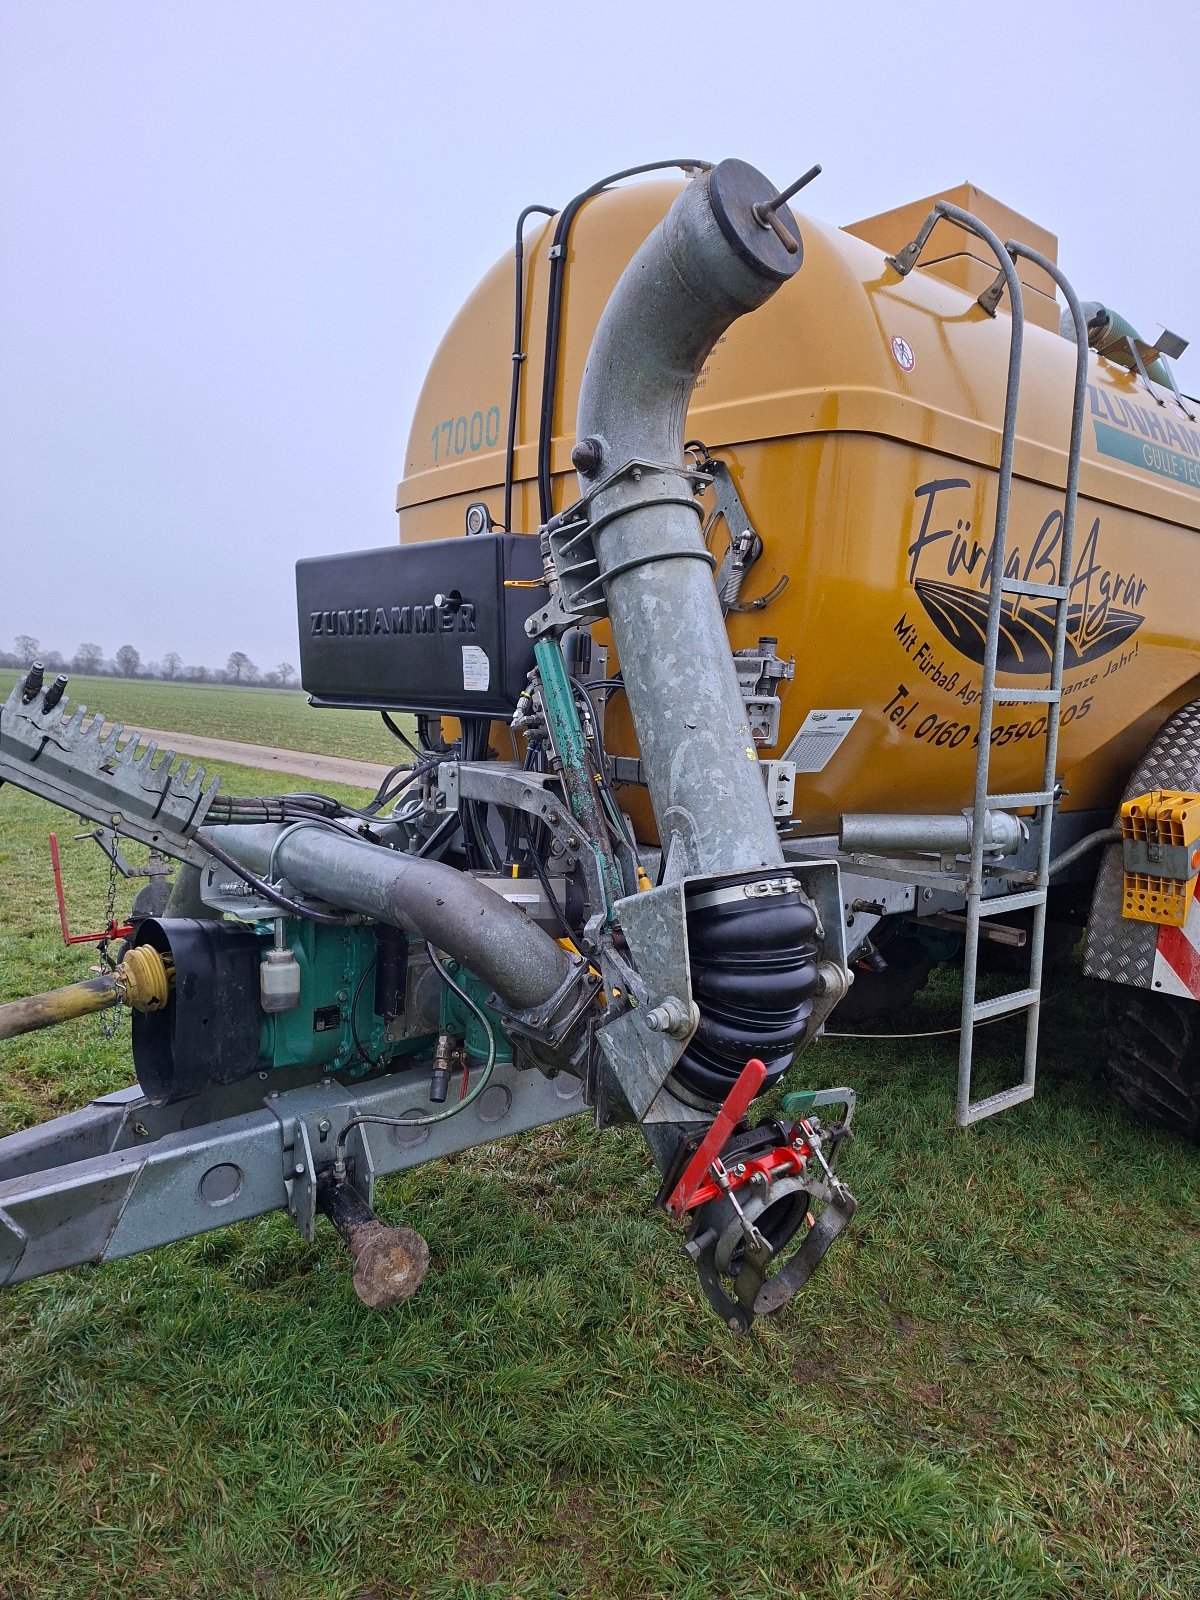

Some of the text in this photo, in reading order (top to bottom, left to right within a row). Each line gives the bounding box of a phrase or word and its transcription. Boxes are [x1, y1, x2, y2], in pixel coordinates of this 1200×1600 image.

[431, 405, 500, 464] 17000
[1068, 516, 1149, 646] Agrar
[310, 603, 477, 638] ZUNHAMMER
[893, 611, 917, 653] Mit
[912, 641, 960, 693] Fürbaß
[1060, 674, 1099, 698] anze
[1102, 641, 1140, 679] Jahr!
[882, 683, 920, 731] Tel.
[914, 713, 971, 749] 0160
[969, 695, 1094, 749] 959005
